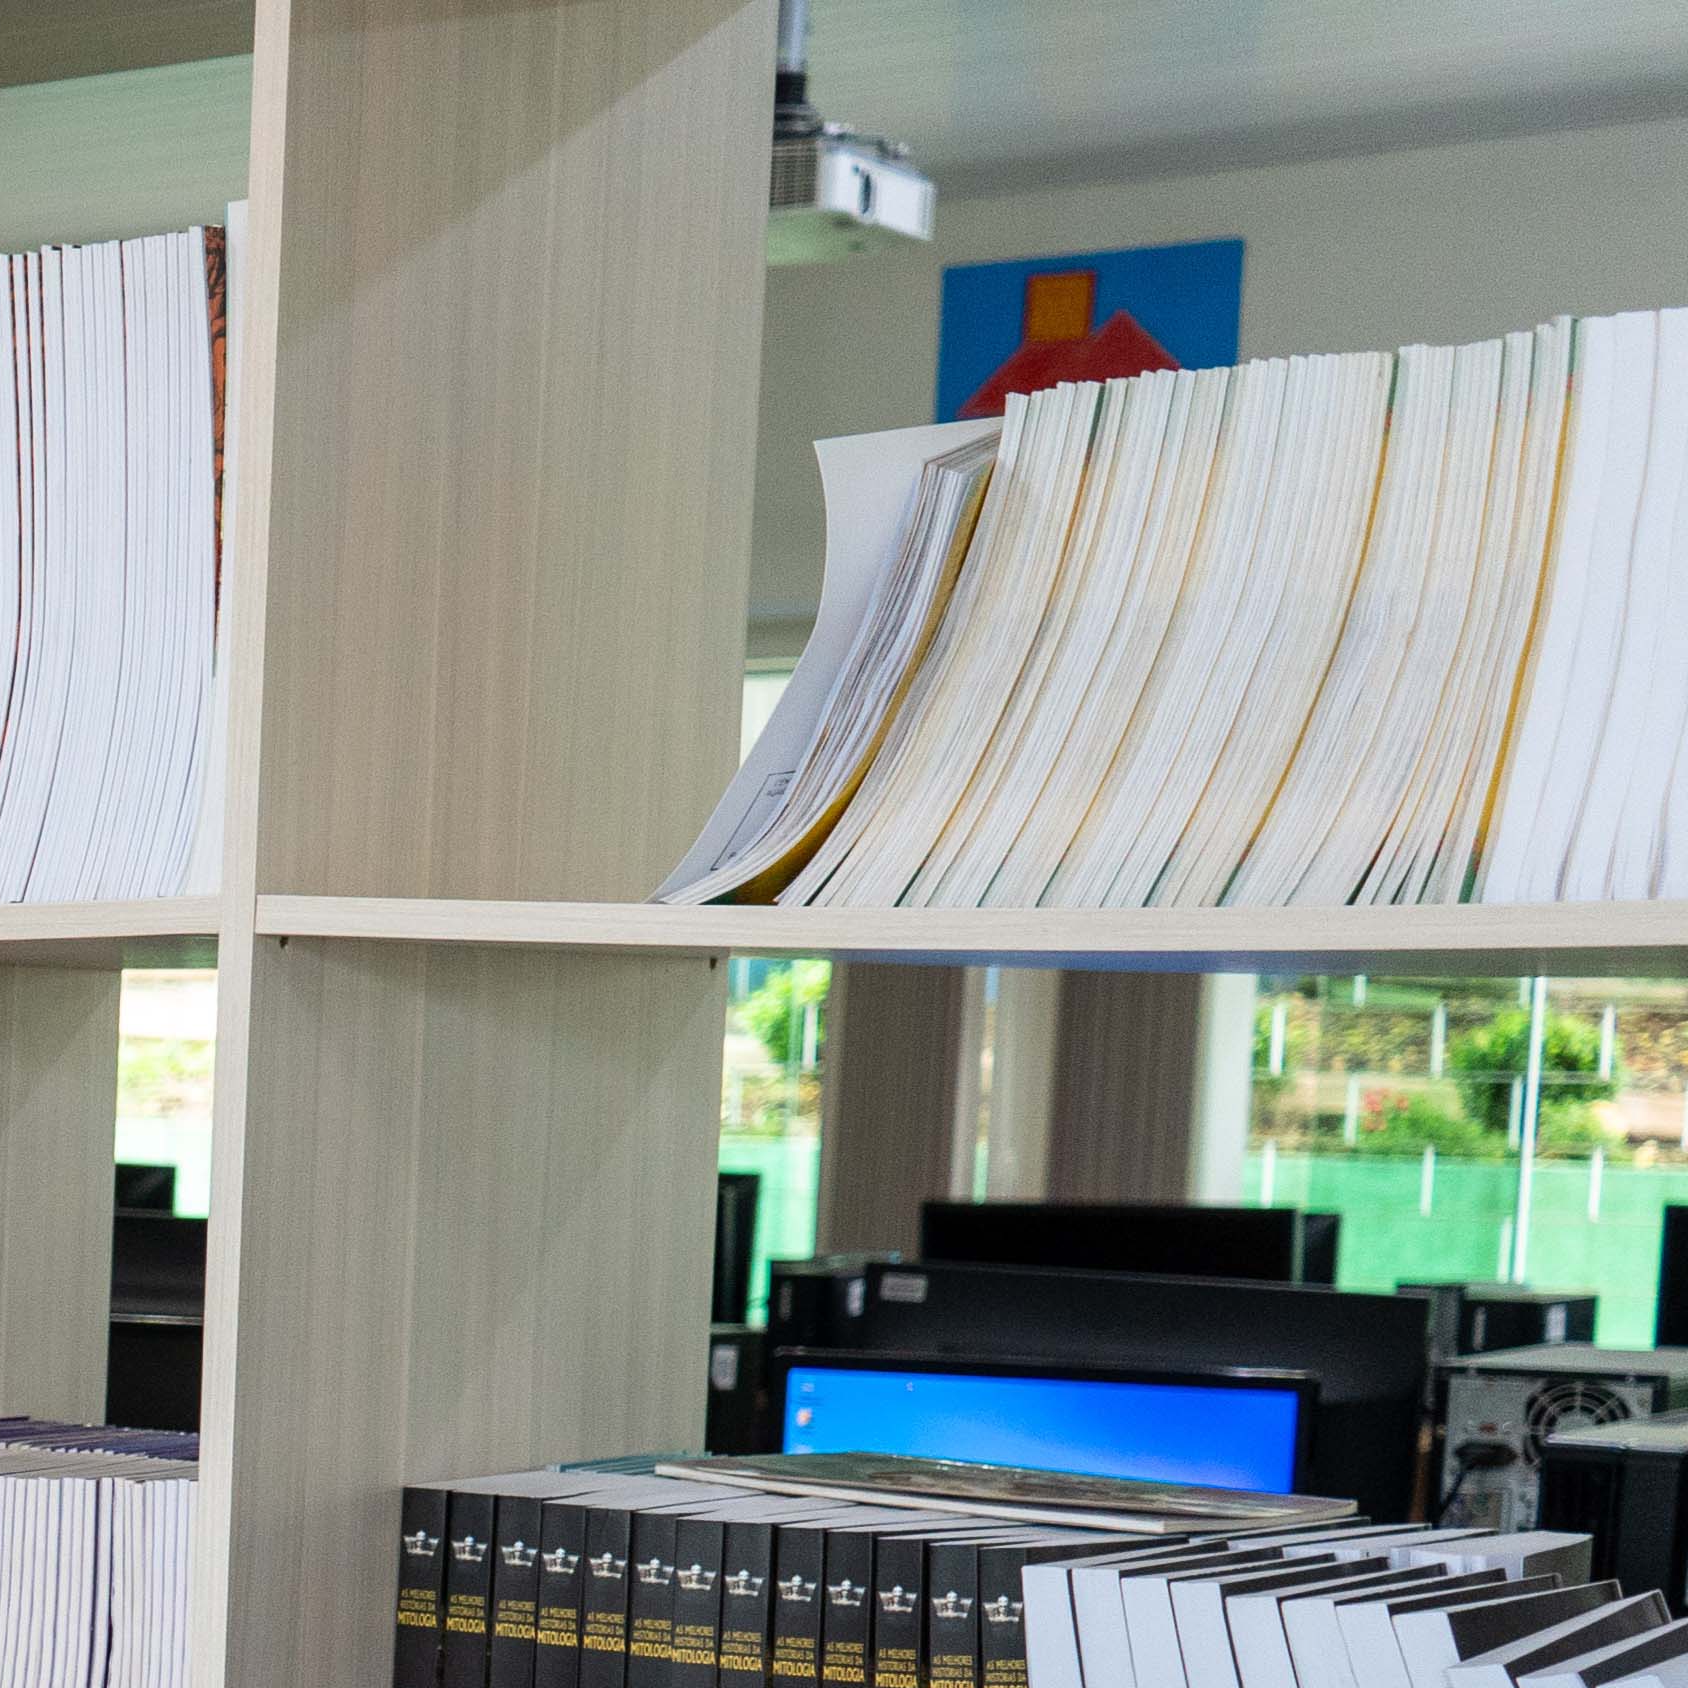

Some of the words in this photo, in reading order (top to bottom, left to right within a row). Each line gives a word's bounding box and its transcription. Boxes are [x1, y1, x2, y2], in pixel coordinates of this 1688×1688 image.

[459, 1594, 485, 1607] MELHORES
[509, 1600, 536, 1613] MELHORES
[447, 1617, 485, 1632] MITOLOGIA
[496, 1623, 535, 1638] MITOLOGIA
[786, 1637, 816, 1649] MELHORES
[888, 1649, 916, 1660] MELHORES
[773, 1661, 815, 1676] MITOLOGIA
[876, 1673, 917, 1688] MITOLOGIA
